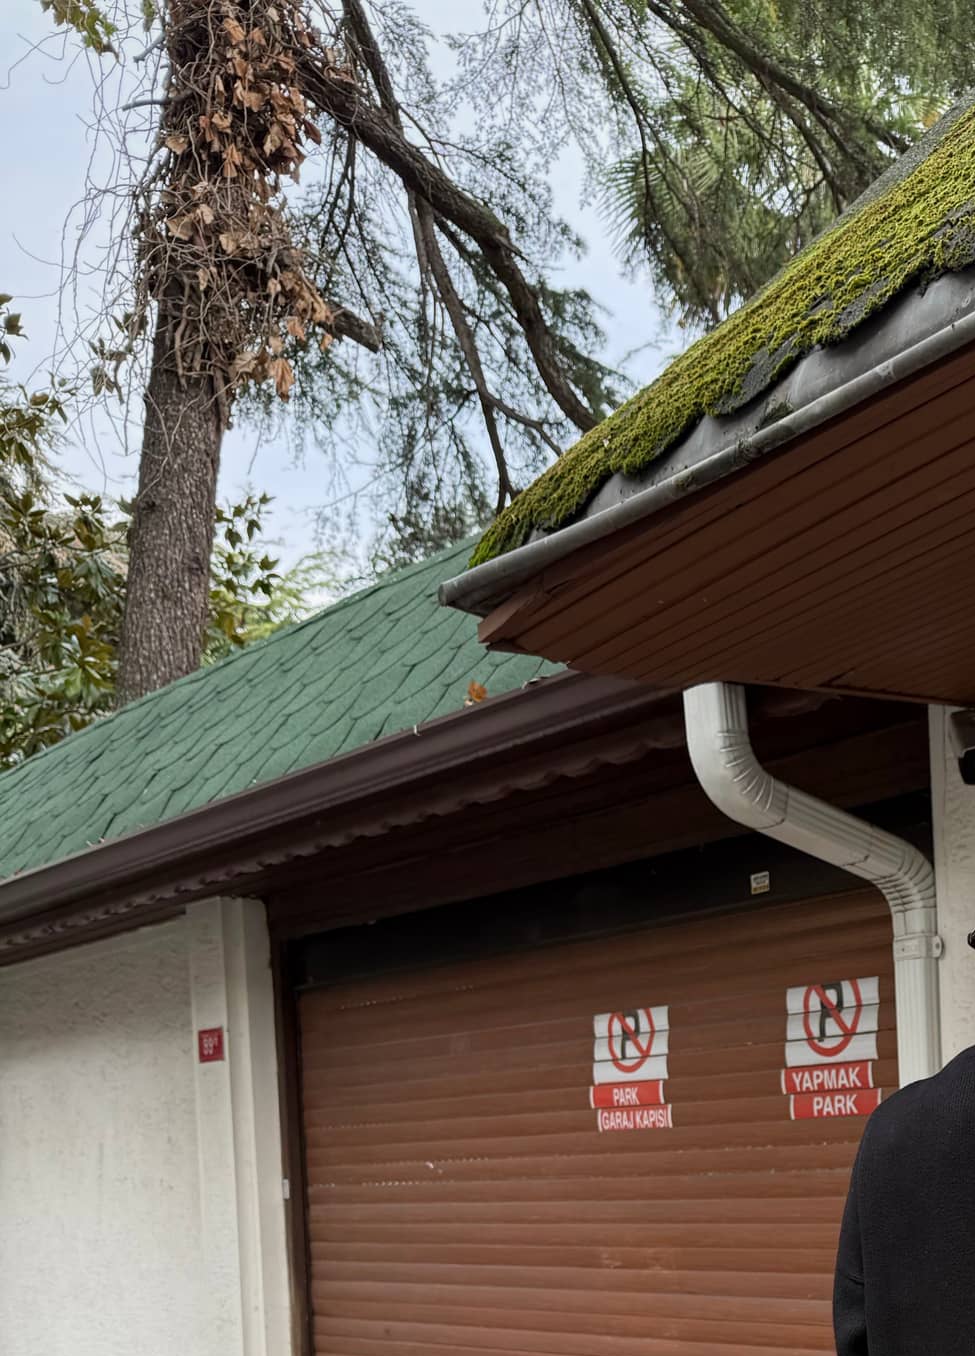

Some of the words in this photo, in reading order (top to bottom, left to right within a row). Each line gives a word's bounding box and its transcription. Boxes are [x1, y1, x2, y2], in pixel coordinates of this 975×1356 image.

[791, 1067, 862, 1092] YAPMAK
[612, 1087, 640, 1106] PARK
[813, 1094, 858, 1117] PARK
[601, 1111, 634, 1130] GARAJ
[636, 1108, 669, 1129] KAPISI
